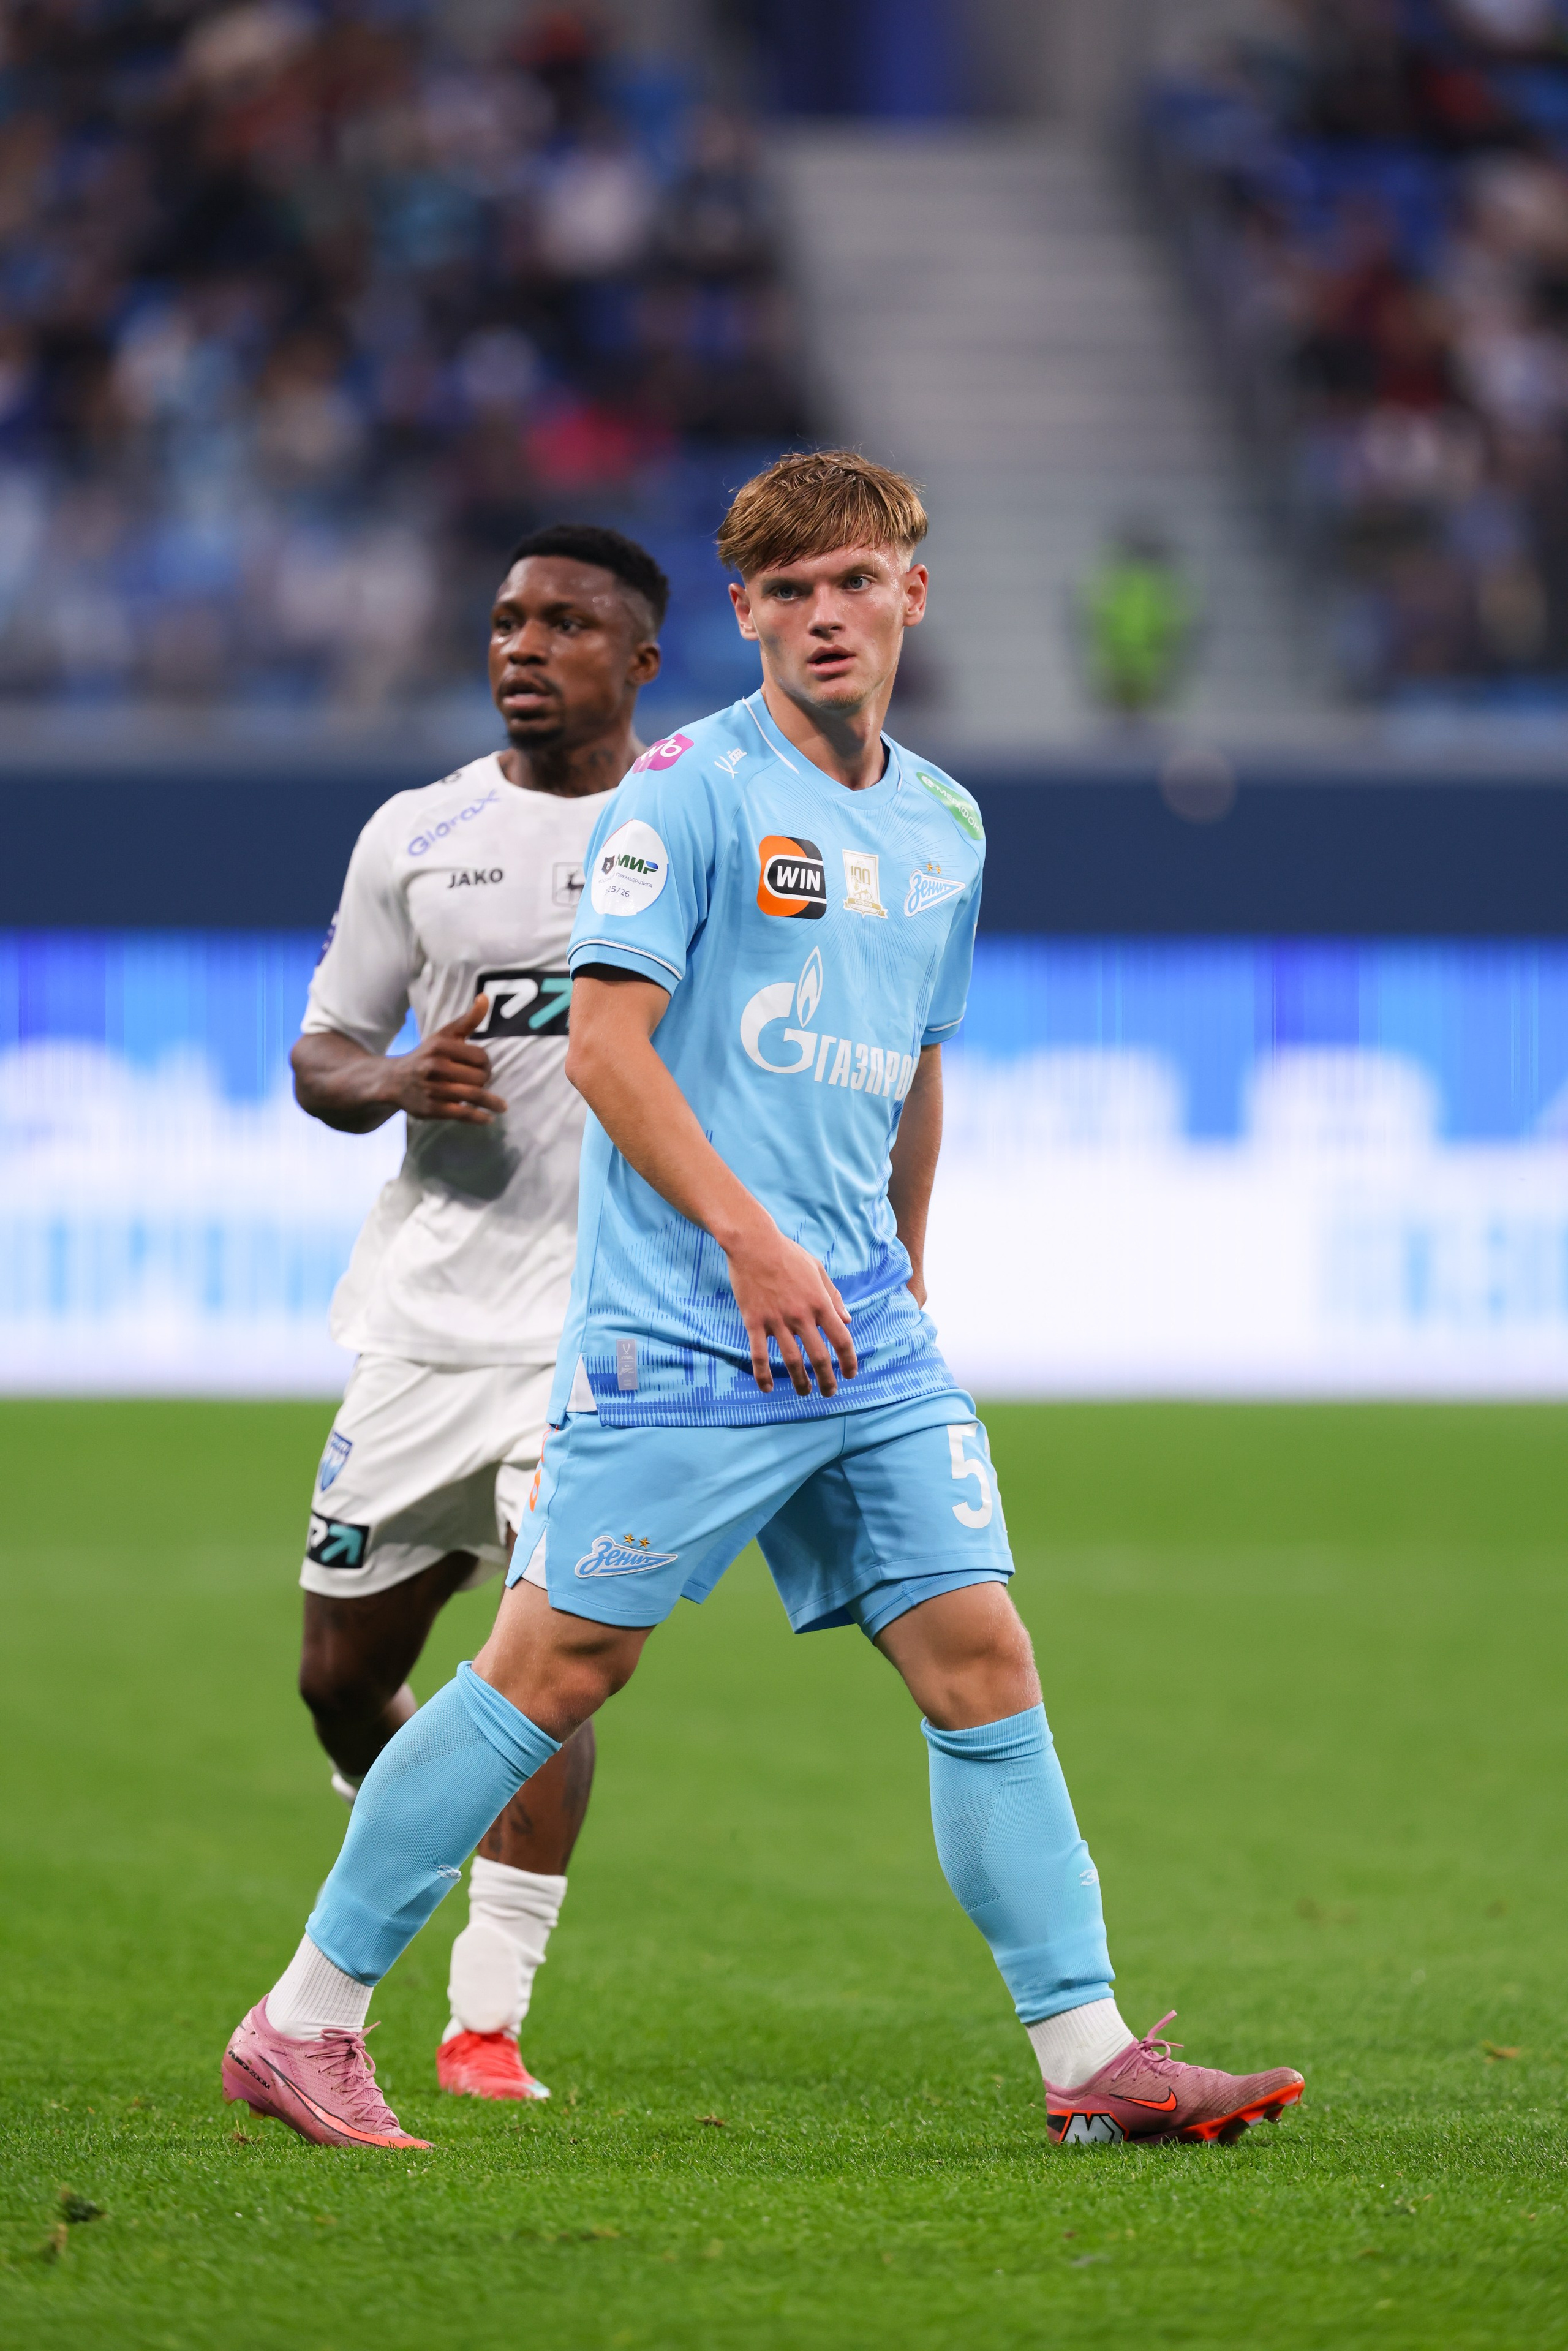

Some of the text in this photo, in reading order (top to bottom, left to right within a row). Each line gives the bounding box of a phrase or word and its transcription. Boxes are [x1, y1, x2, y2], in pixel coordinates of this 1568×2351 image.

[615, 854, 658, 874] МИР
[447, 869, 503, 889] JAKO
[777, 866, 820, 891] WIN
[814, 1035, 918, 1101] ГАЗПРО
[947, 1423, 1008, 1532] 5
[249, 2069, 271, 2090] ZOOM
